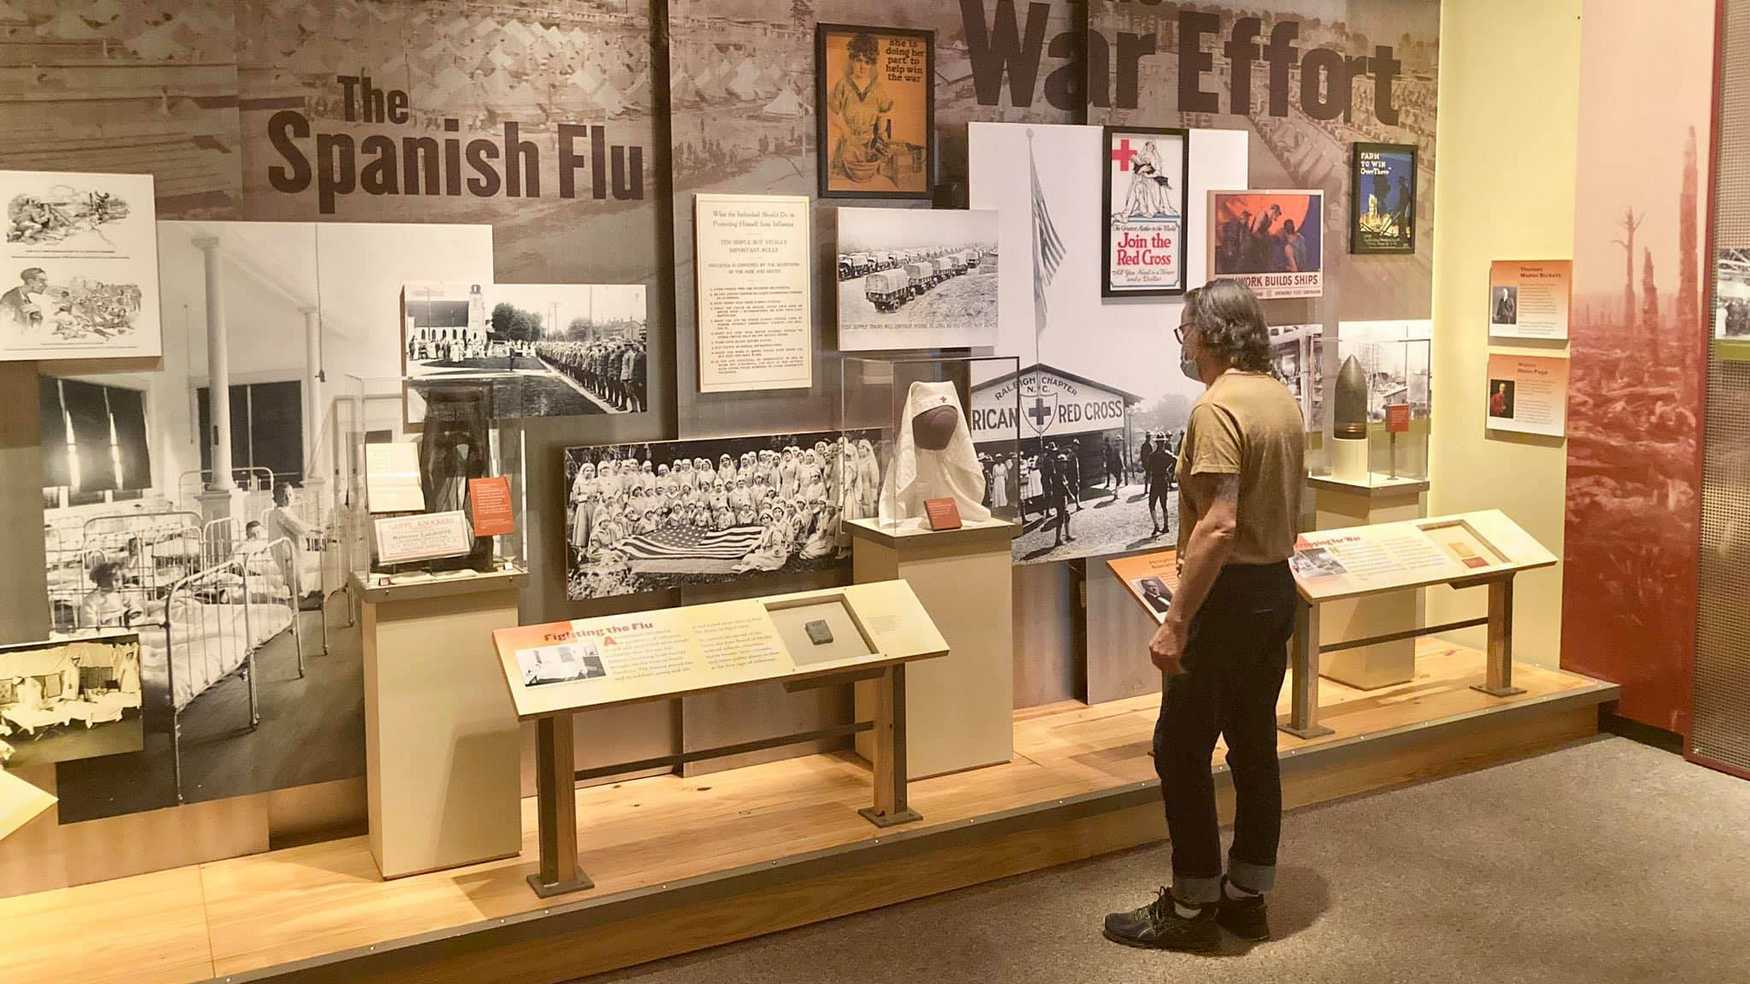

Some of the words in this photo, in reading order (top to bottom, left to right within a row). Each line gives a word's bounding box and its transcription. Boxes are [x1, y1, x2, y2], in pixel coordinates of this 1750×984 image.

[960, 0, 1156, 111] War
[1178, 10, 1401, 125] Effort
[337, 75, 409, 124] The
[268, 110, 541, 214] Spanish
[558, 123, 643, 201] Flu
[1117, 232, 1147, 249] Join
[1151, 232, 1171, 249] the
[1117, 249, 1140, 266] Red
[1142, 249, 1172, 266] Cross
[1264, 275, 1292, 286] BUILDS
[1294, 274, 1318, 285] SHIPS
[994, 376, 1036, 401] RALEGH
[1041, 376, 1078, 397] CHAPTER
[972, 407, 1019, 430] RICAN
[1058, 403, 1082, 423] RED
[1084, 400, 1123, 420] CROSS
[543, 629, 605, 642] Fighting
[606, 625, 630, 634] the
[631, 622, 654, 630] Flu
